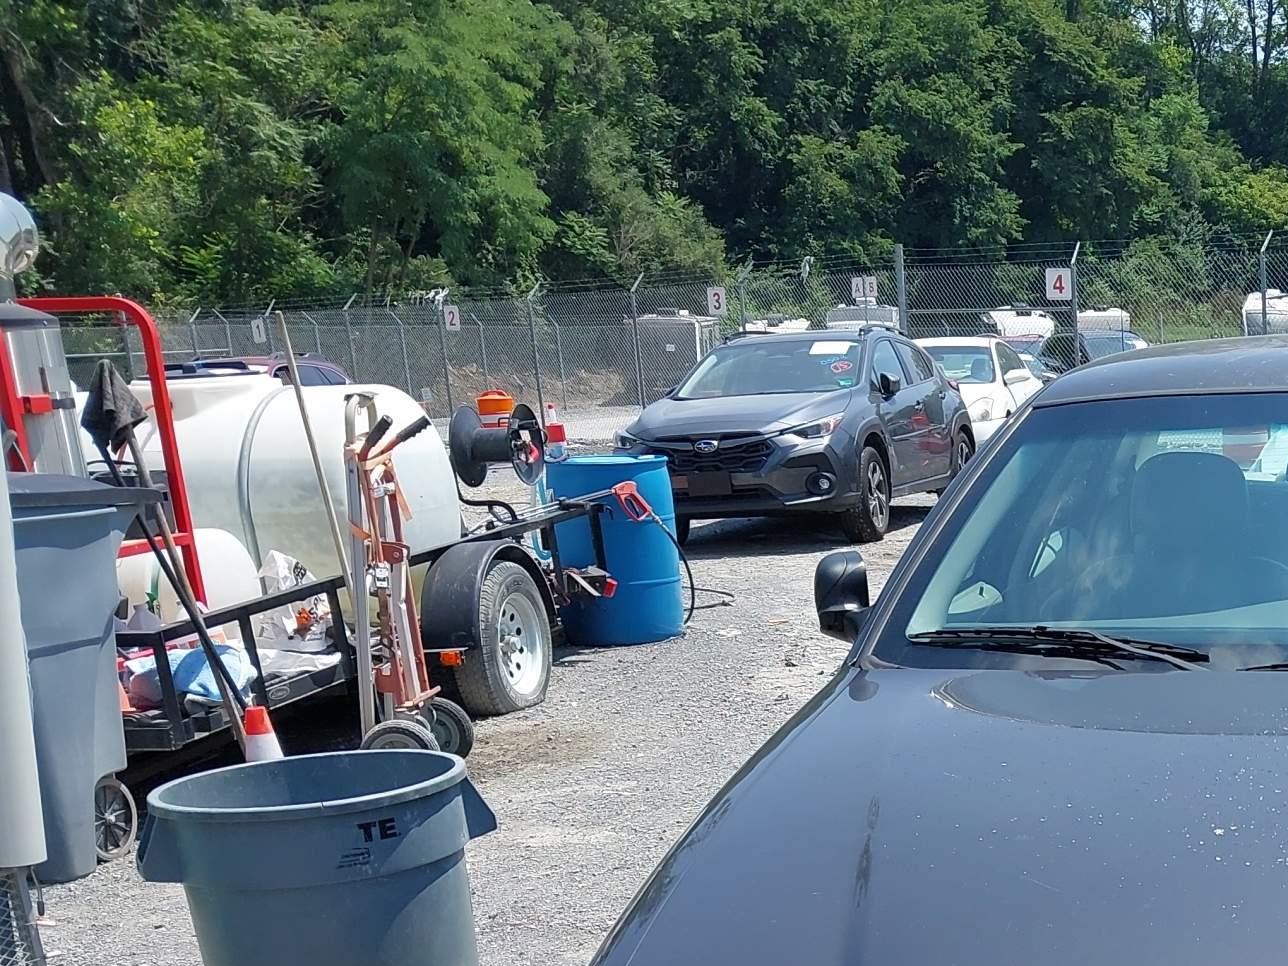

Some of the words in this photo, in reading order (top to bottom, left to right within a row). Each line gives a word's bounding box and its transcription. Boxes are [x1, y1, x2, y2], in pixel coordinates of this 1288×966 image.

[1053, 274, 1064, 294] 4
[712, 292, 722, 311] 3
[448, 310, 457, 327] 2
